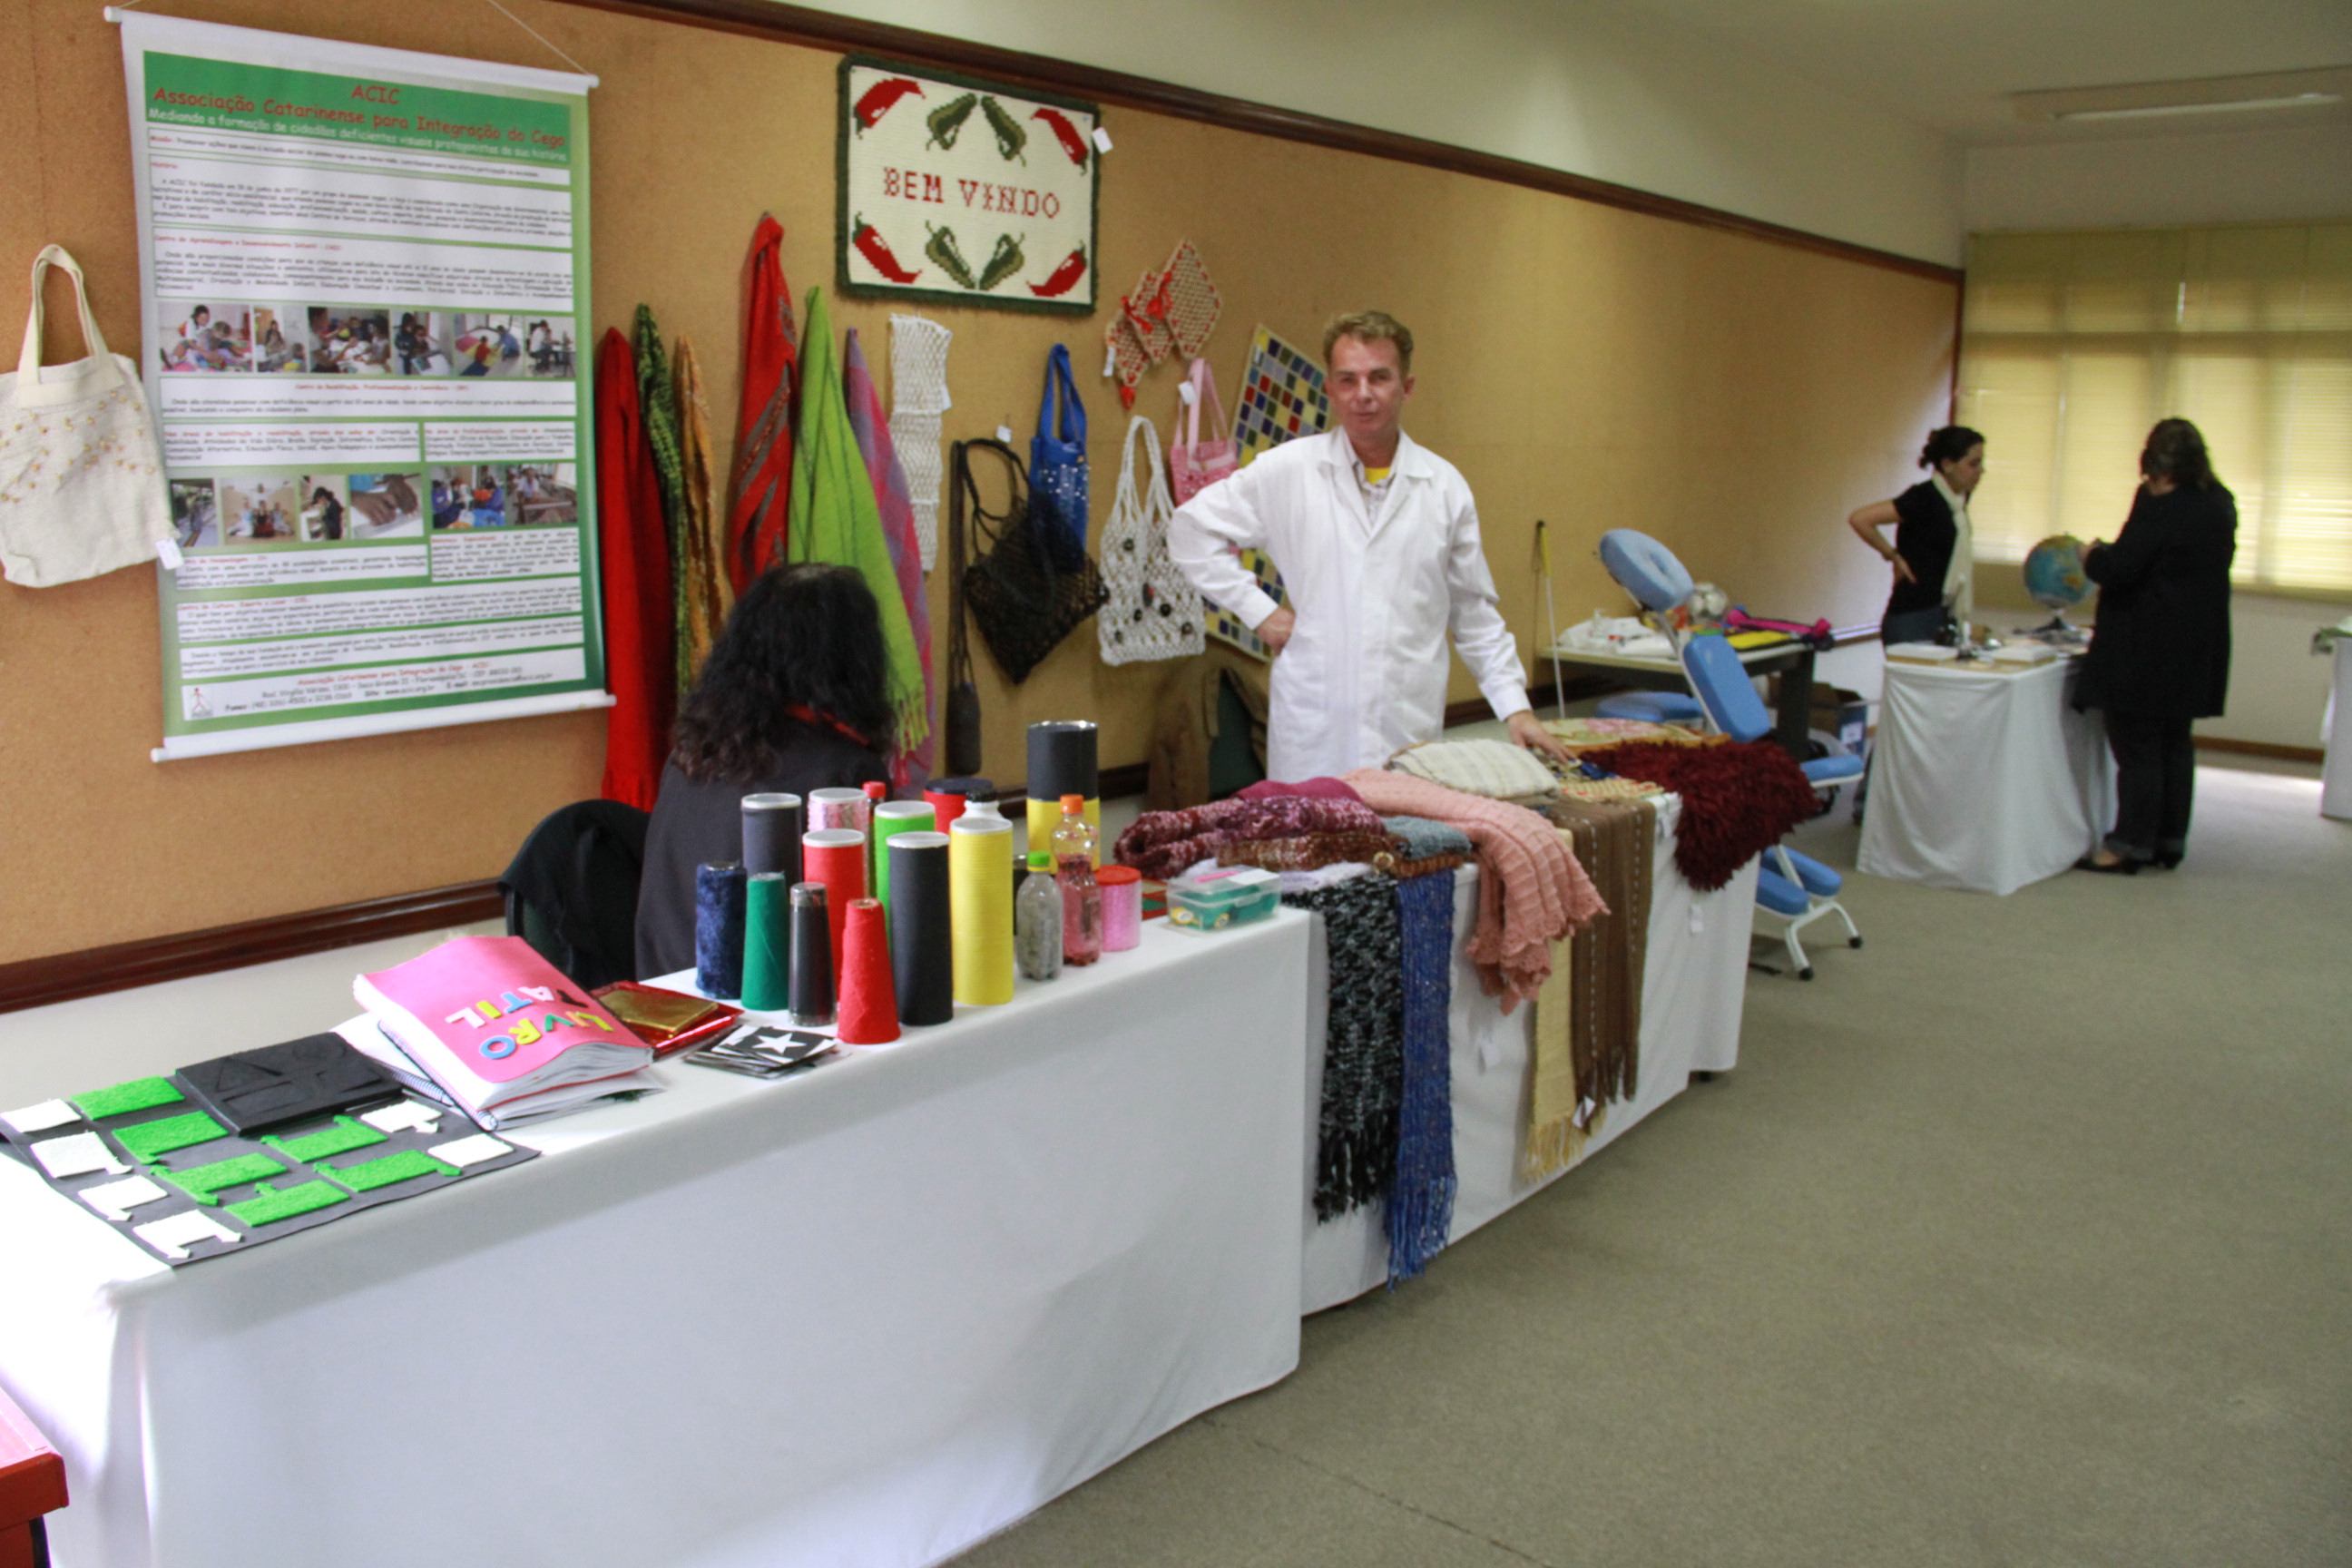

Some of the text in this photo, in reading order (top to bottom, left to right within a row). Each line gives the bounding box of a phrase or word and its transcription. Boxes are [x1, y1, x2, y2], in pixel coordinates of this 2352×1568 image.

[153, 87, 566, 150] Associação Catarinense para Integração do Cego
[350, 84, 400, 104] ACIC
[884, 167, 1060, 219] BEM VINDO
[479, 1011, 614, 1060] LIVRO
